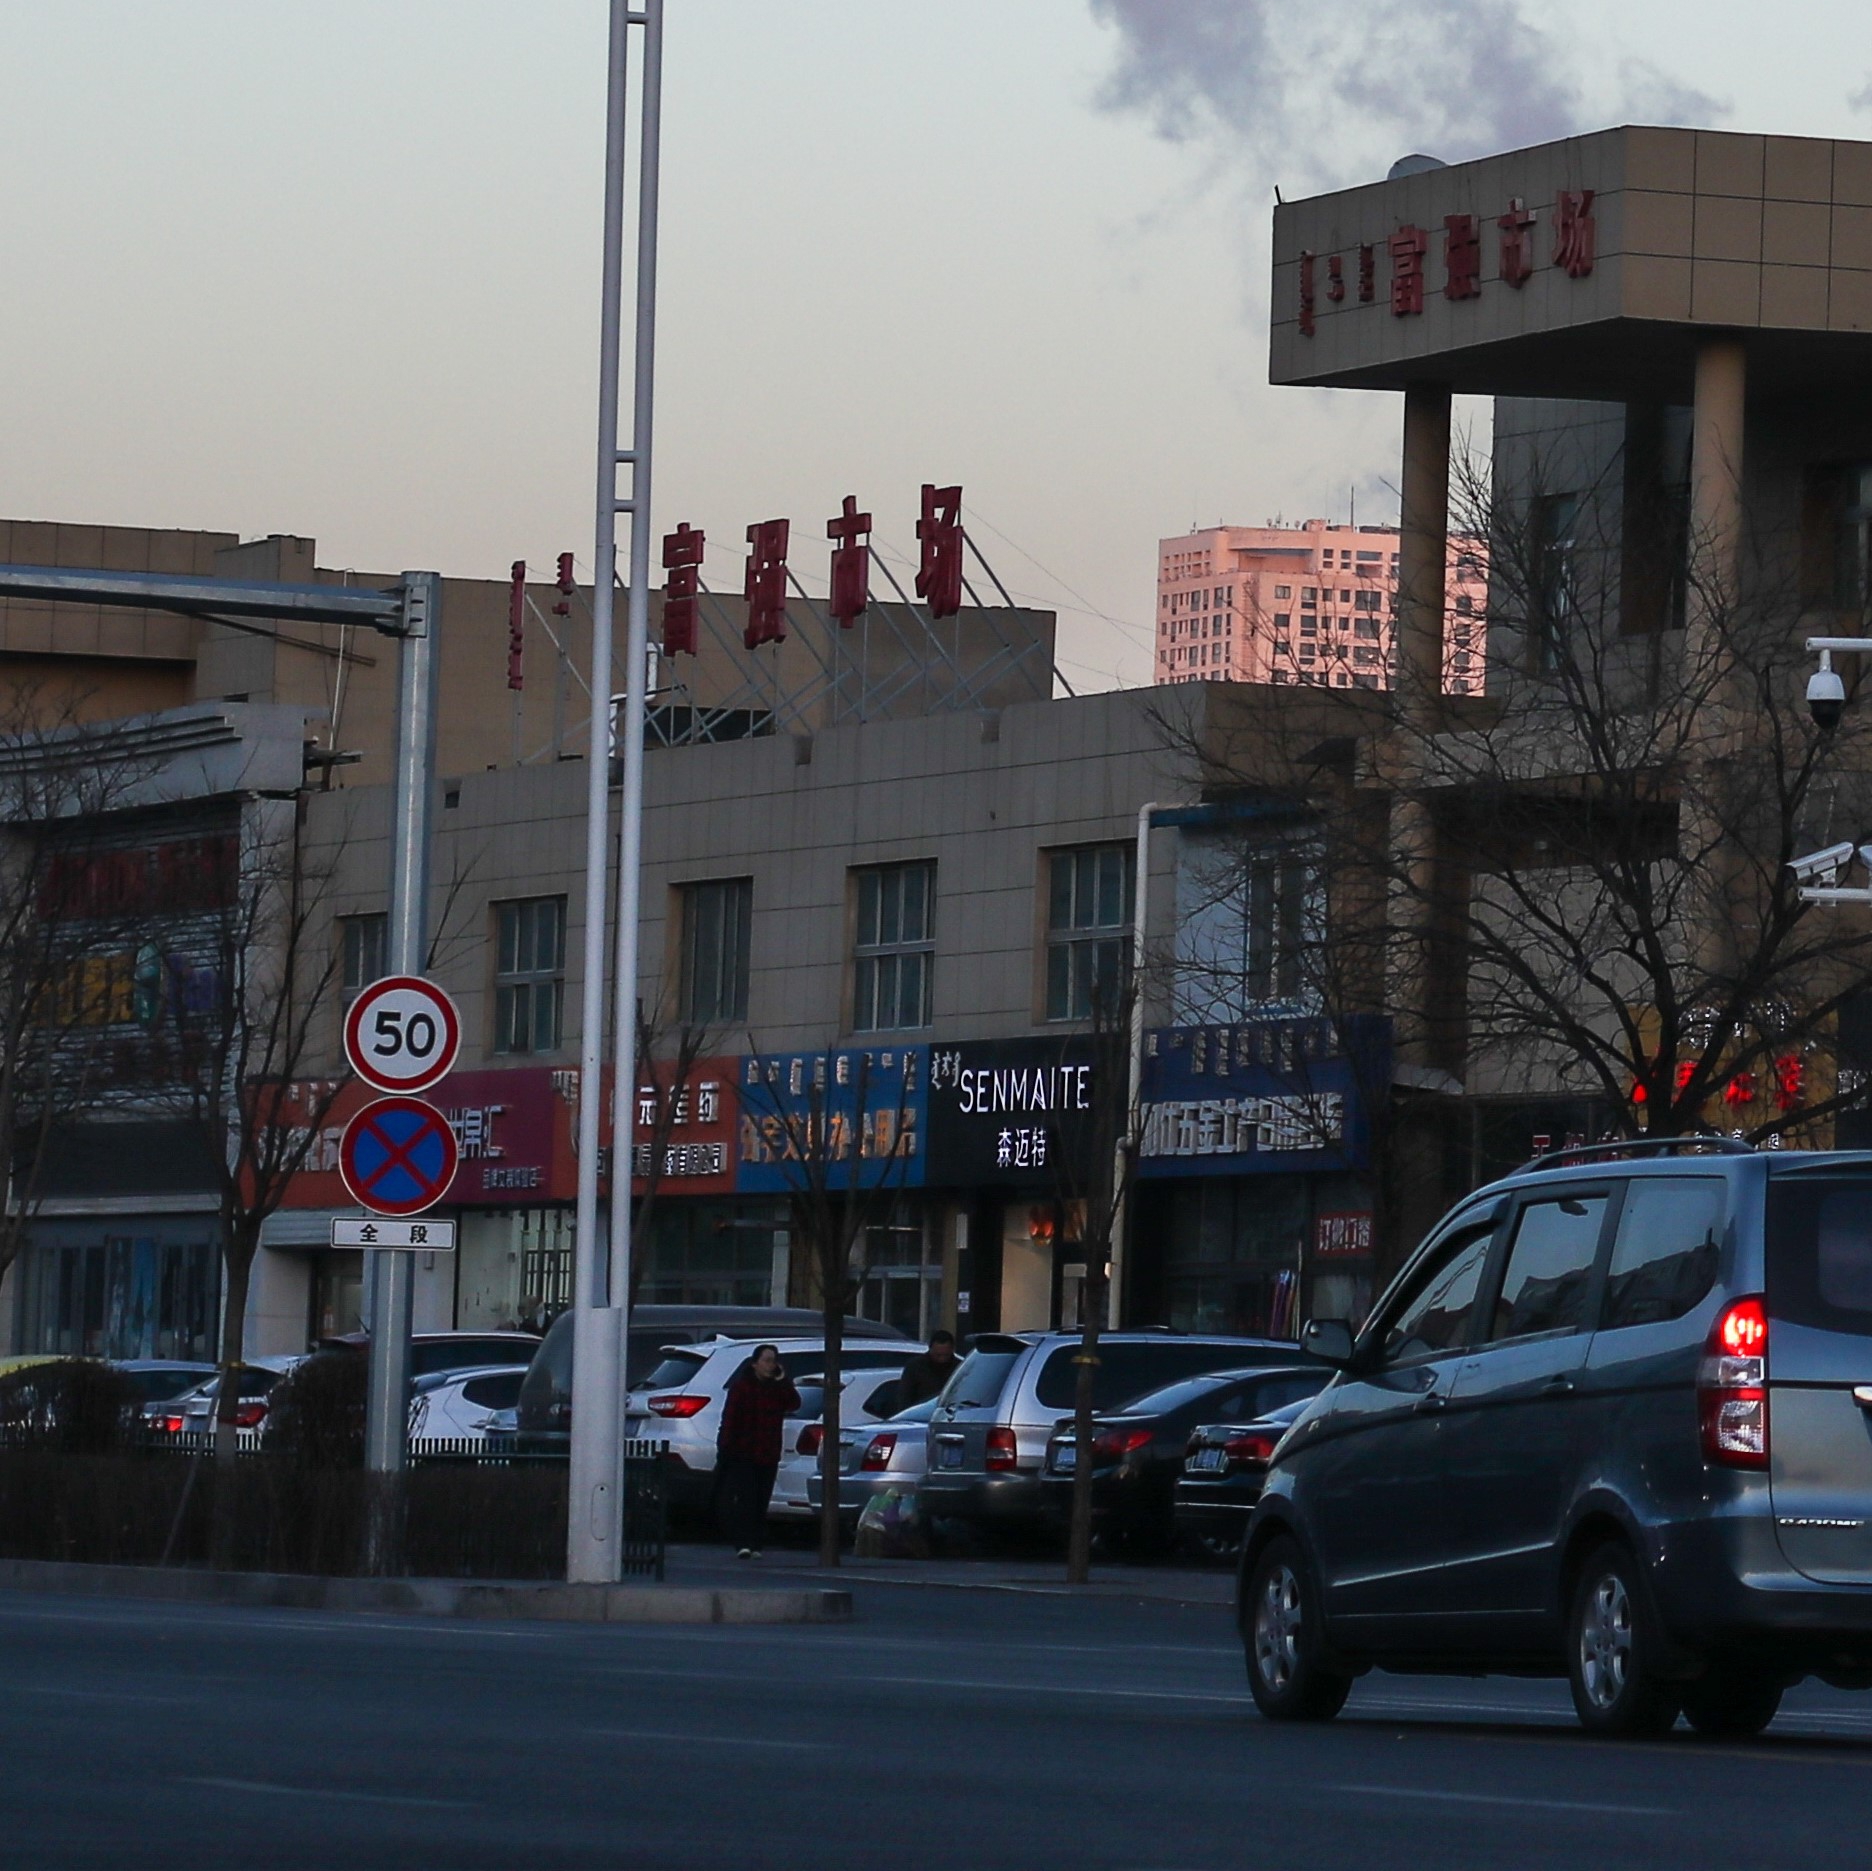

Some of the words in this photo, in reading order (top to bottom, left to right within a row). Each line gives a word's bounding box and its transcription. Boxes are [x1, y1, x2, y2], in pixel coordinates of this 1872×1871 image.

[374, 1011, 435, 1058] 50
[958, 1065, 1091, 1114] SENMAITE
[995, 1126, 1046, 1169] 森迈特
[360, 1224, 428, 1244] 全段
